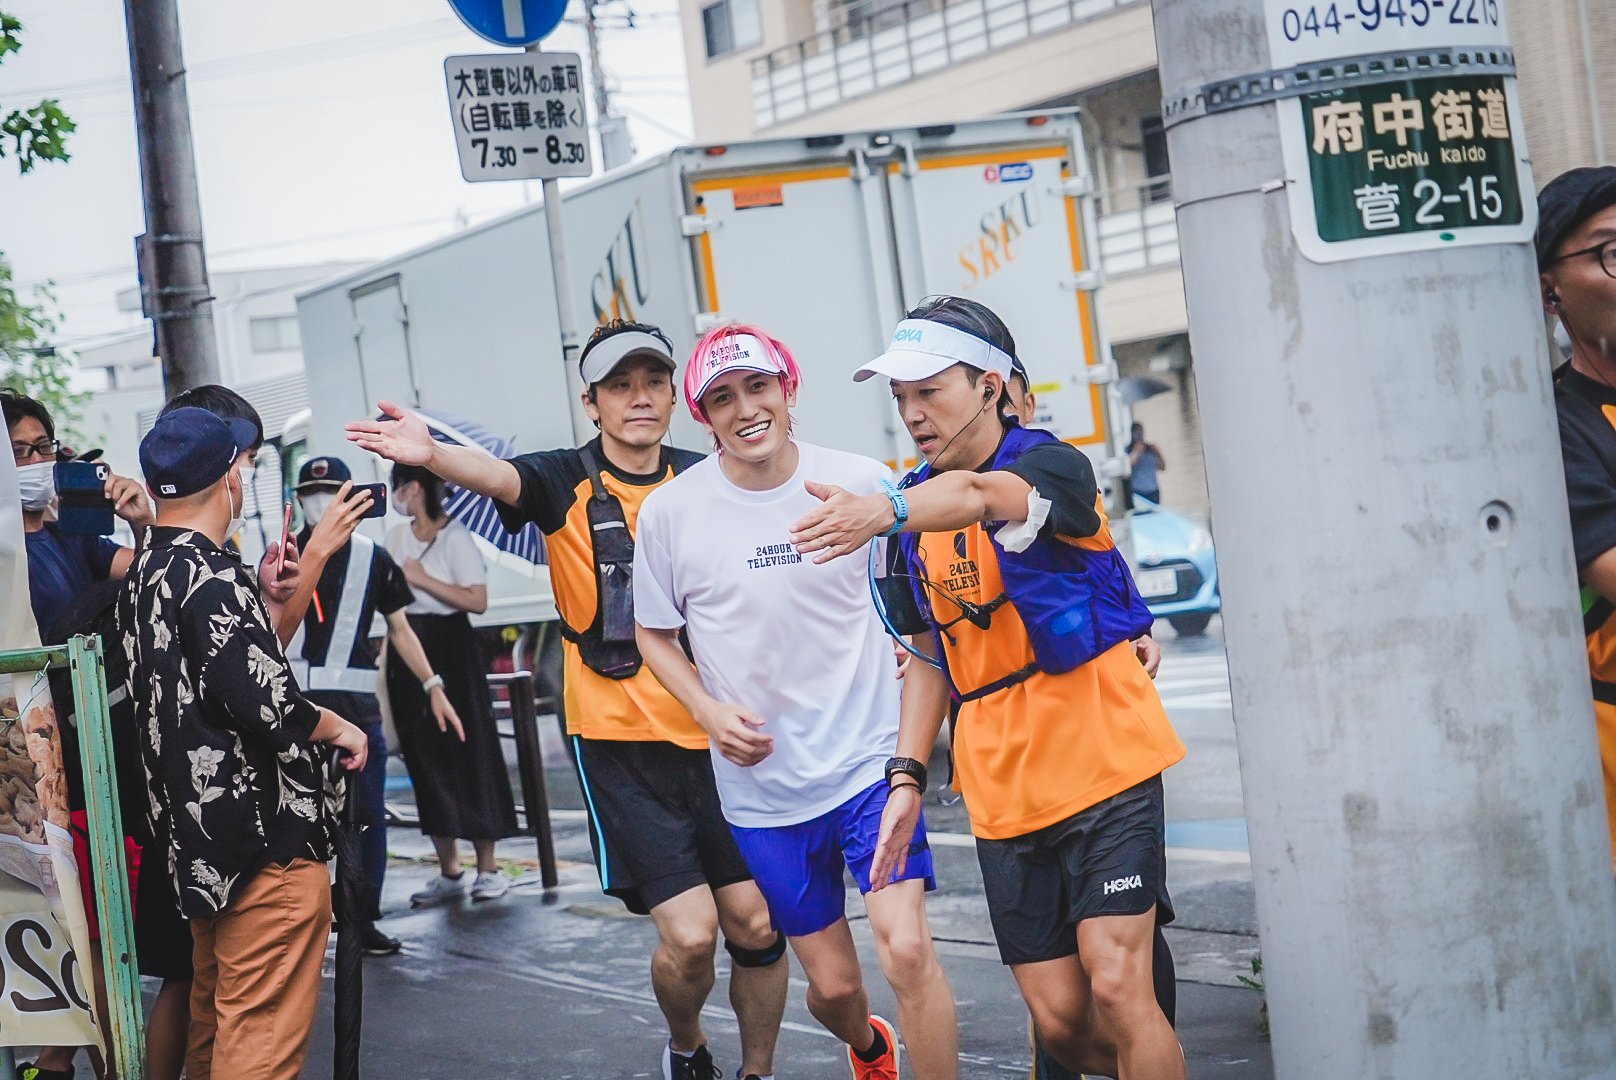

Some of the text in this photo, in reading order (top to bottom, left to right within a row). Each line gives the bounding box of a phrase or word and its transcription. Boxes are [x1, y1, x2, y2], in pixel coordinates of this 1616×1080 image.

[454, 65, 580, 99] 大型等以外の車両
[1312, 88, 1509, 155] 府中街道
[1367, 149, 1429, 171] Fuchu
[1413, 175, 1502, 224] 2-15
[706, 350, 750, 368] ELEVISION
[756, 543, 792, 557] 24HOUR
[747, 553, 802, 569] TELEVISION
[1103, 874, 1142, 895] HOKA
